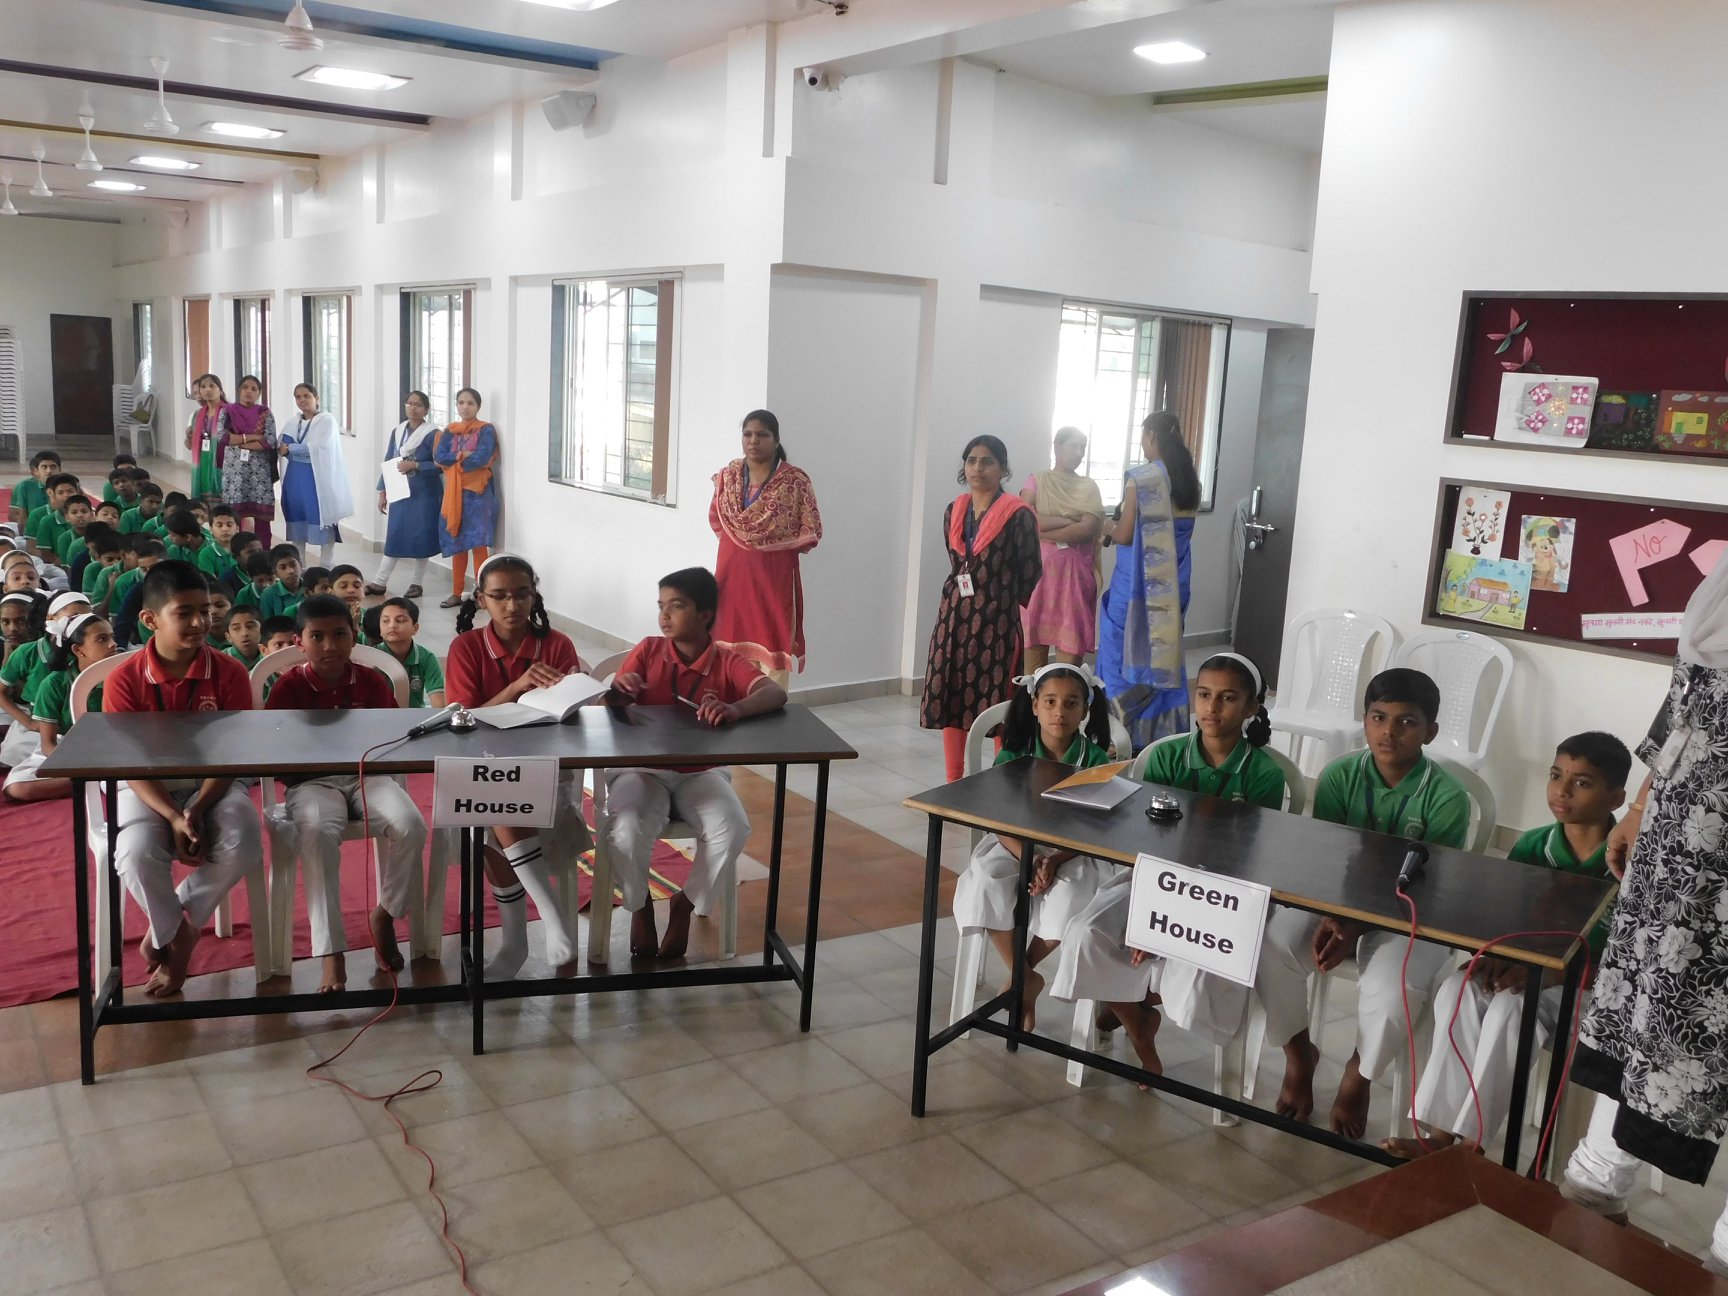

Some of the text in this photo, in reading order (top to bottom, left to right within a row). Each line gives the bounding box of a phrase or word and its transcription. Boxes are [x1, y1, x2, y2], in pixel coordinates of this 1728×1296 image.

[472, 764, 521, 783] Red
[454, 798, 534, 814] House
[1157, 871, 1239, 912] Green
[1149, 911, 1234, 955] House
